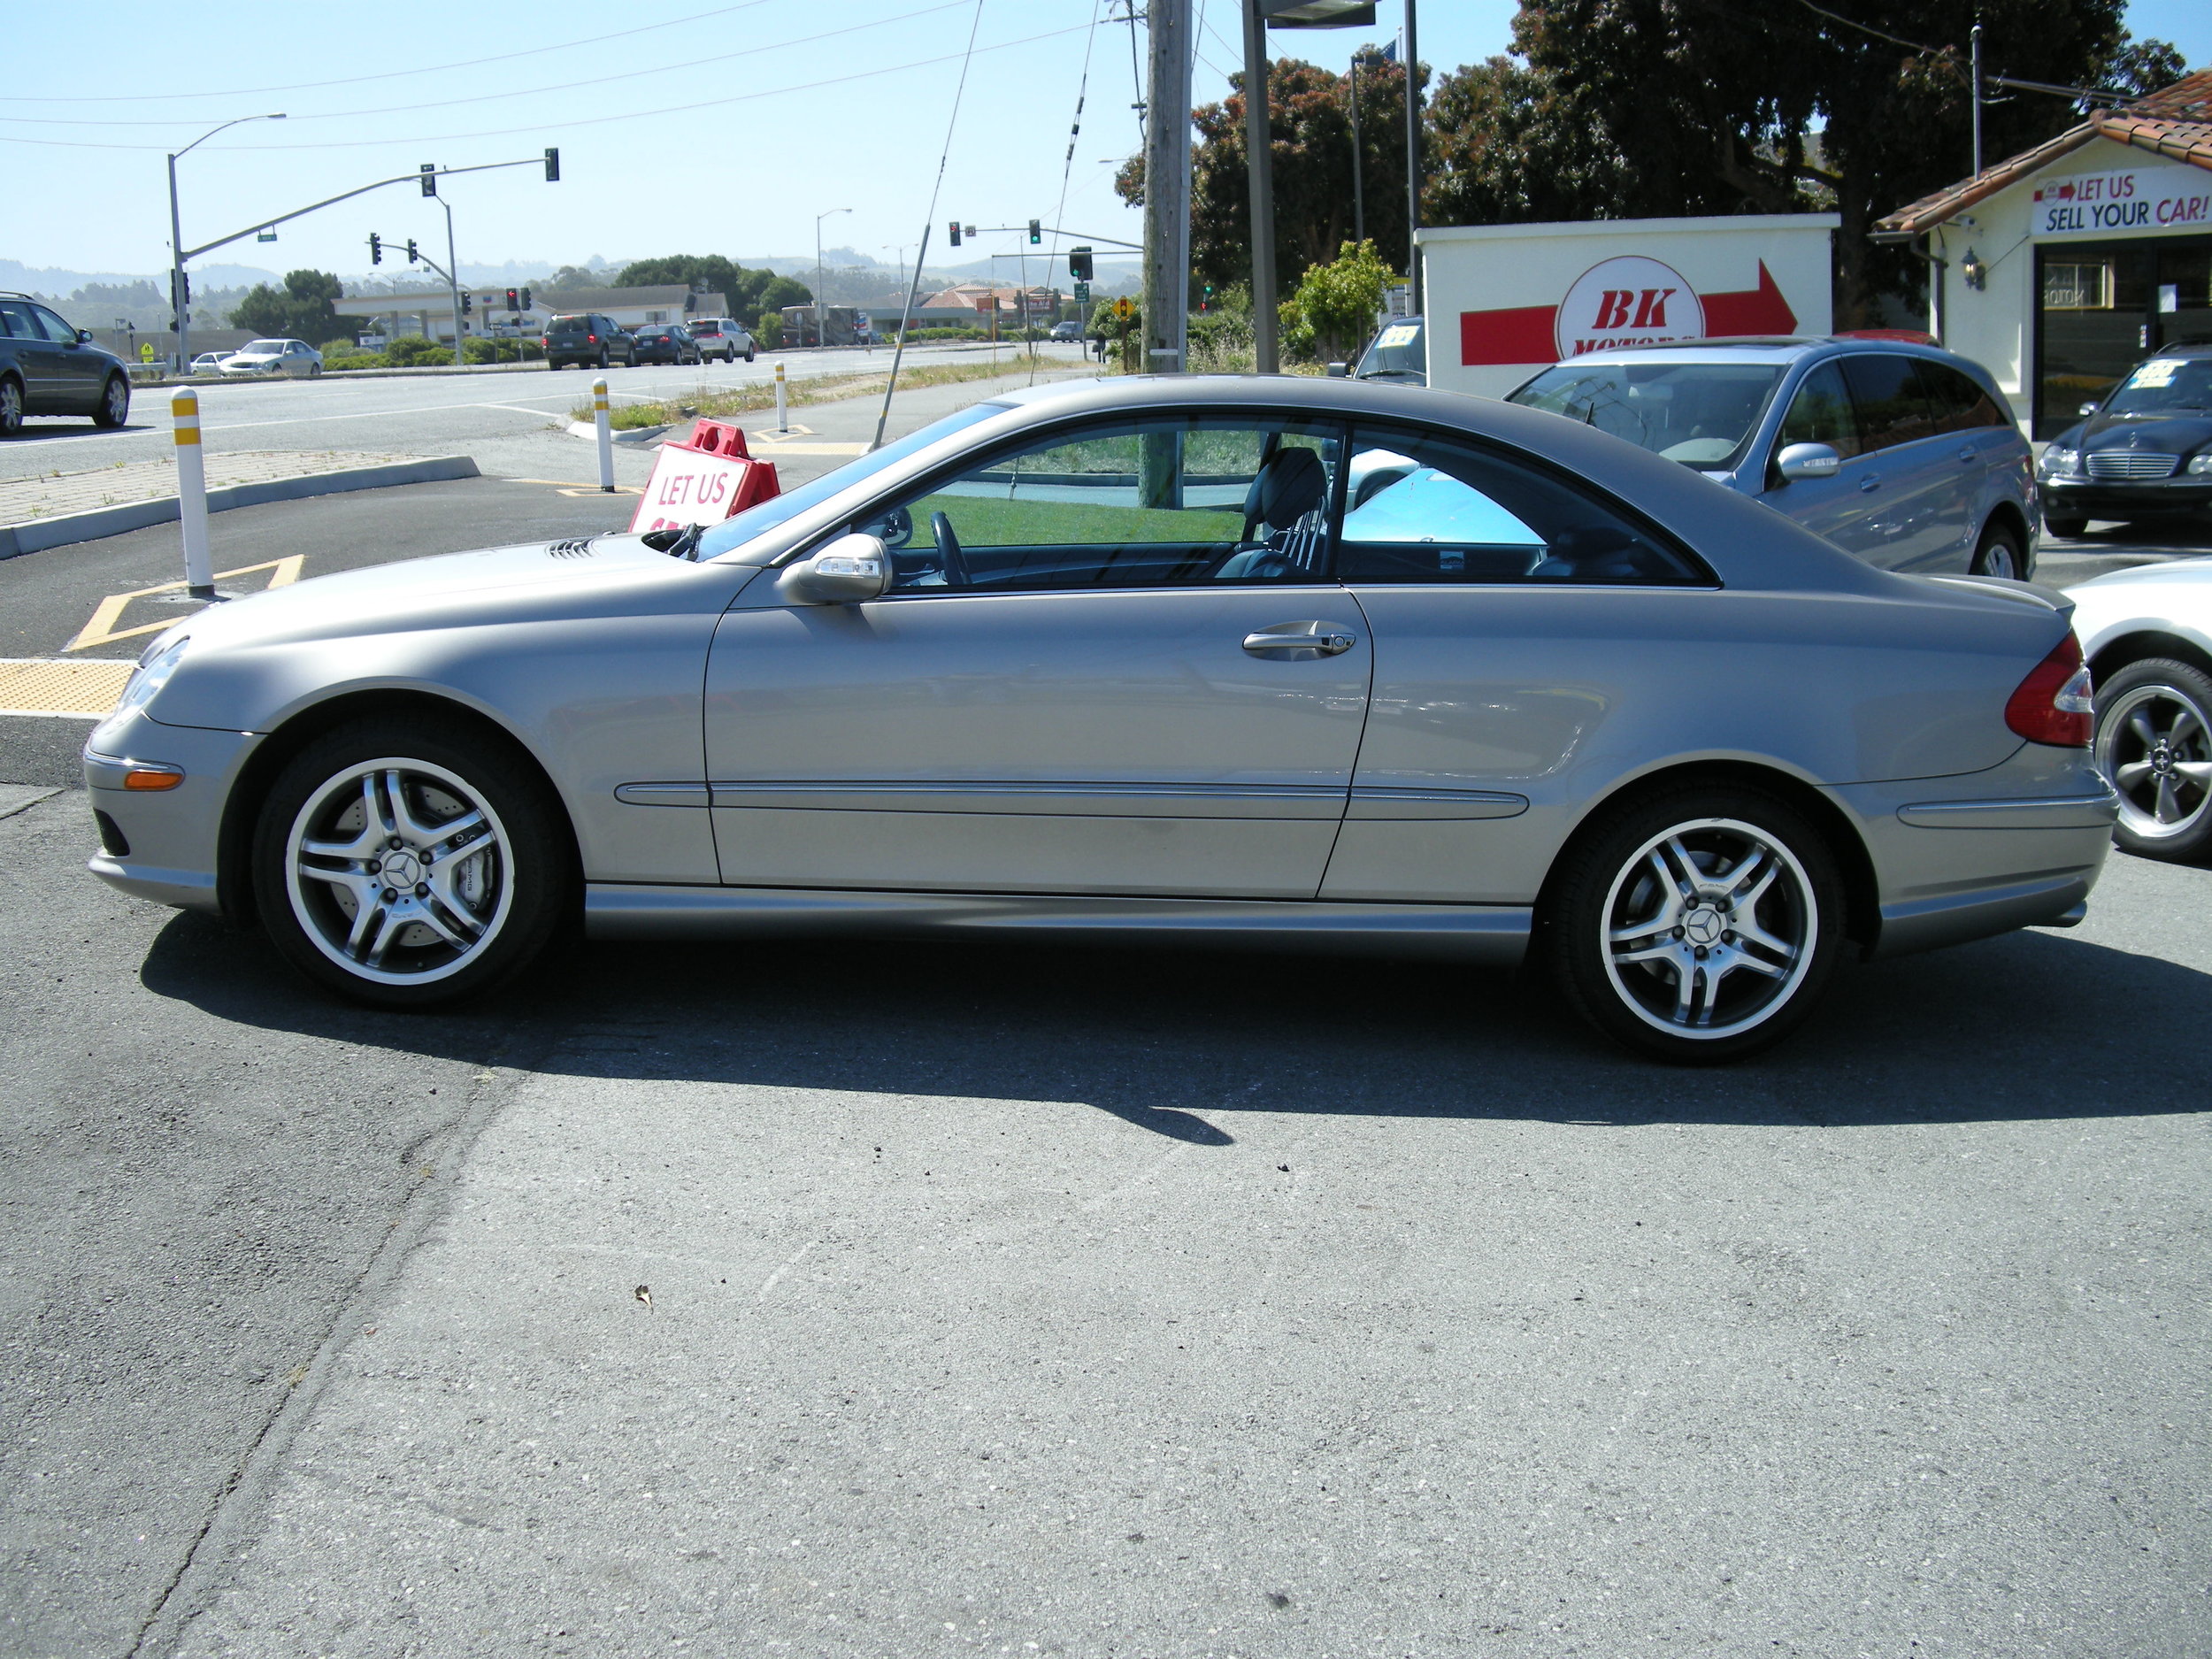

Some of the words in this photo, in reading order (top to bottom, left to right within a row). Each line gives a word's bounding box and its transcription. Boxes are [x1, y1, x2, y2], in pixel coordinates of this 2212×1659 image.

[2078, 178, 2104, 202] LET
[2109, 174, 2135, 198] US
[2046, 206, 2085, 232] SELL
[2091, 201, 2150, 228] YOUR
[2155, 196, 2210, 224] CAR!
[1591, 288, 1678, 330] BK
[658, 474, 695, 505] LET
[696, 472, 729, 504] US
